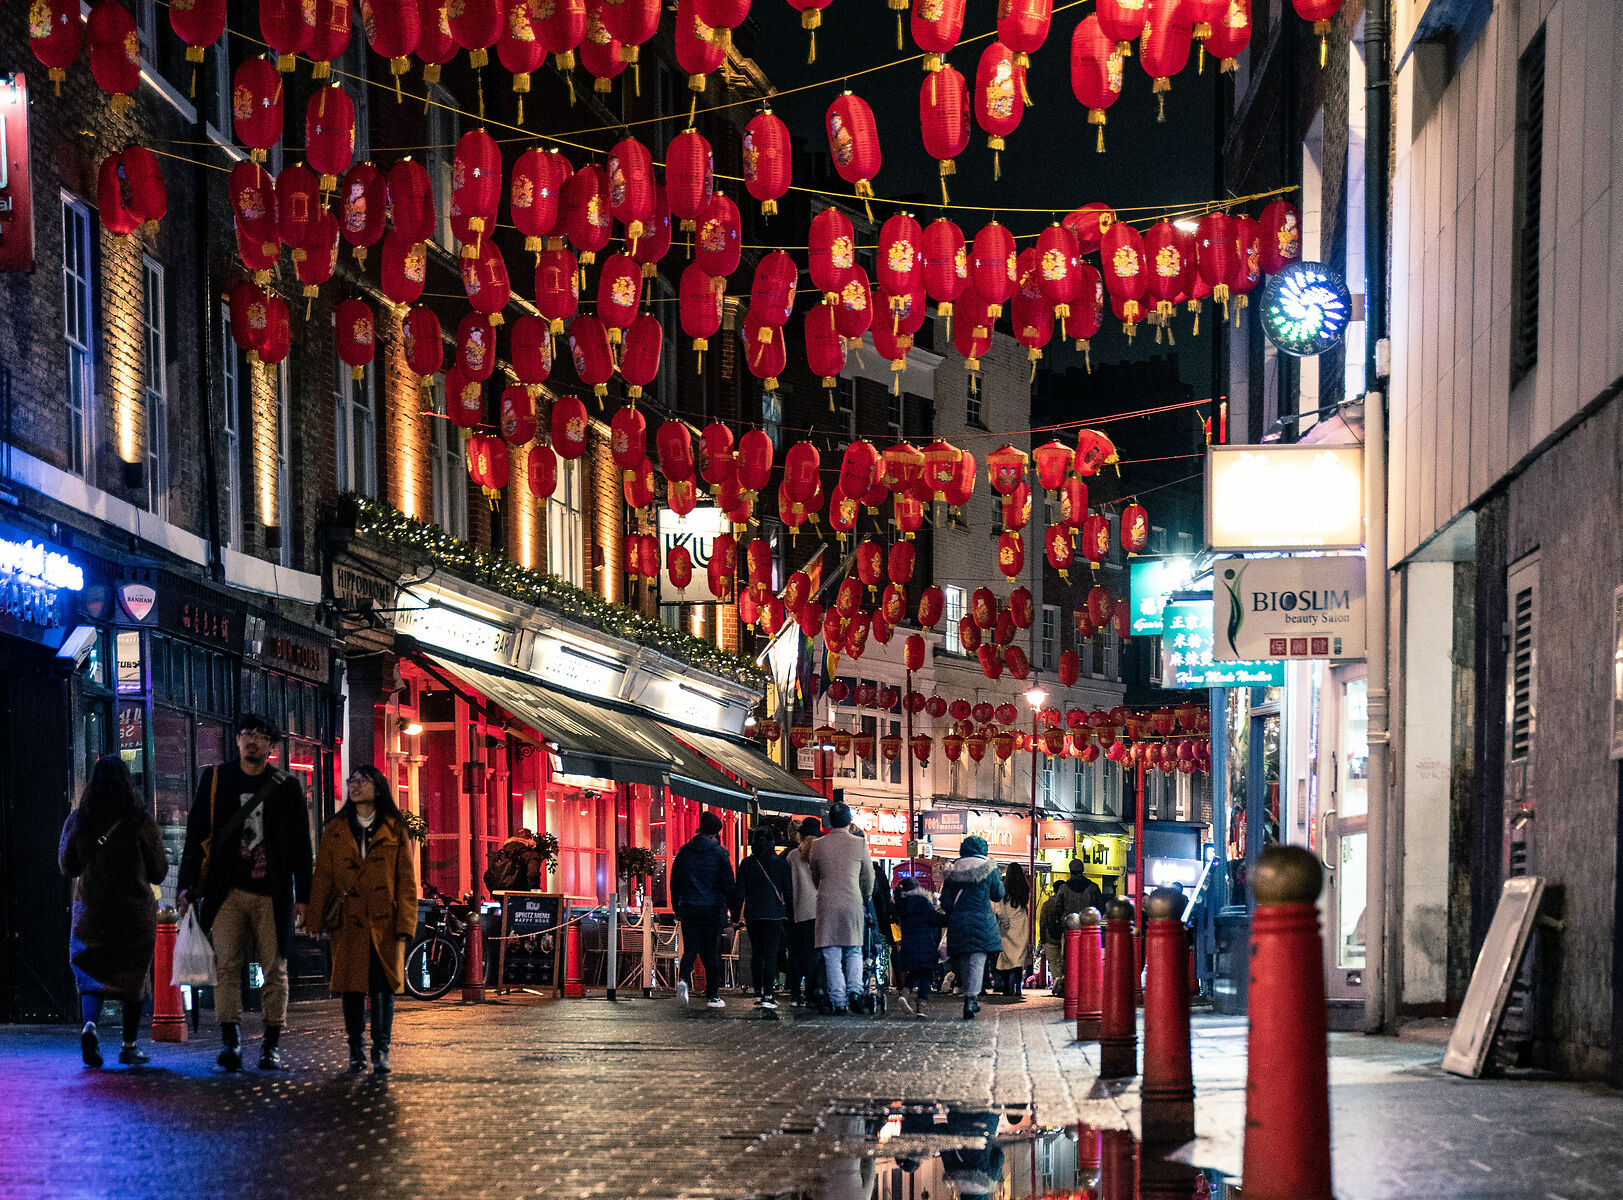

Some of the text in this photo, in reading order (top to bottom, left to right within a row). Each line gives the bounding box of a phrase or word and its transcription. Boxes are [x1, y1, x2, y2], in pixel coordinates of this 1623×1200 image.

[337, 568, 391, 603] HIPPODROME
[127, 595, 153, 604] BANHAM
[1251, 589, 1350, 612] BIOSLIM
[1285, 613, 1350, 626] beauty Salon
[1236, 669, 1273, 683] Noodles
[869, 834, 903, 847] MEDICINE
[514, 911, 534, 919] SPRITZ
